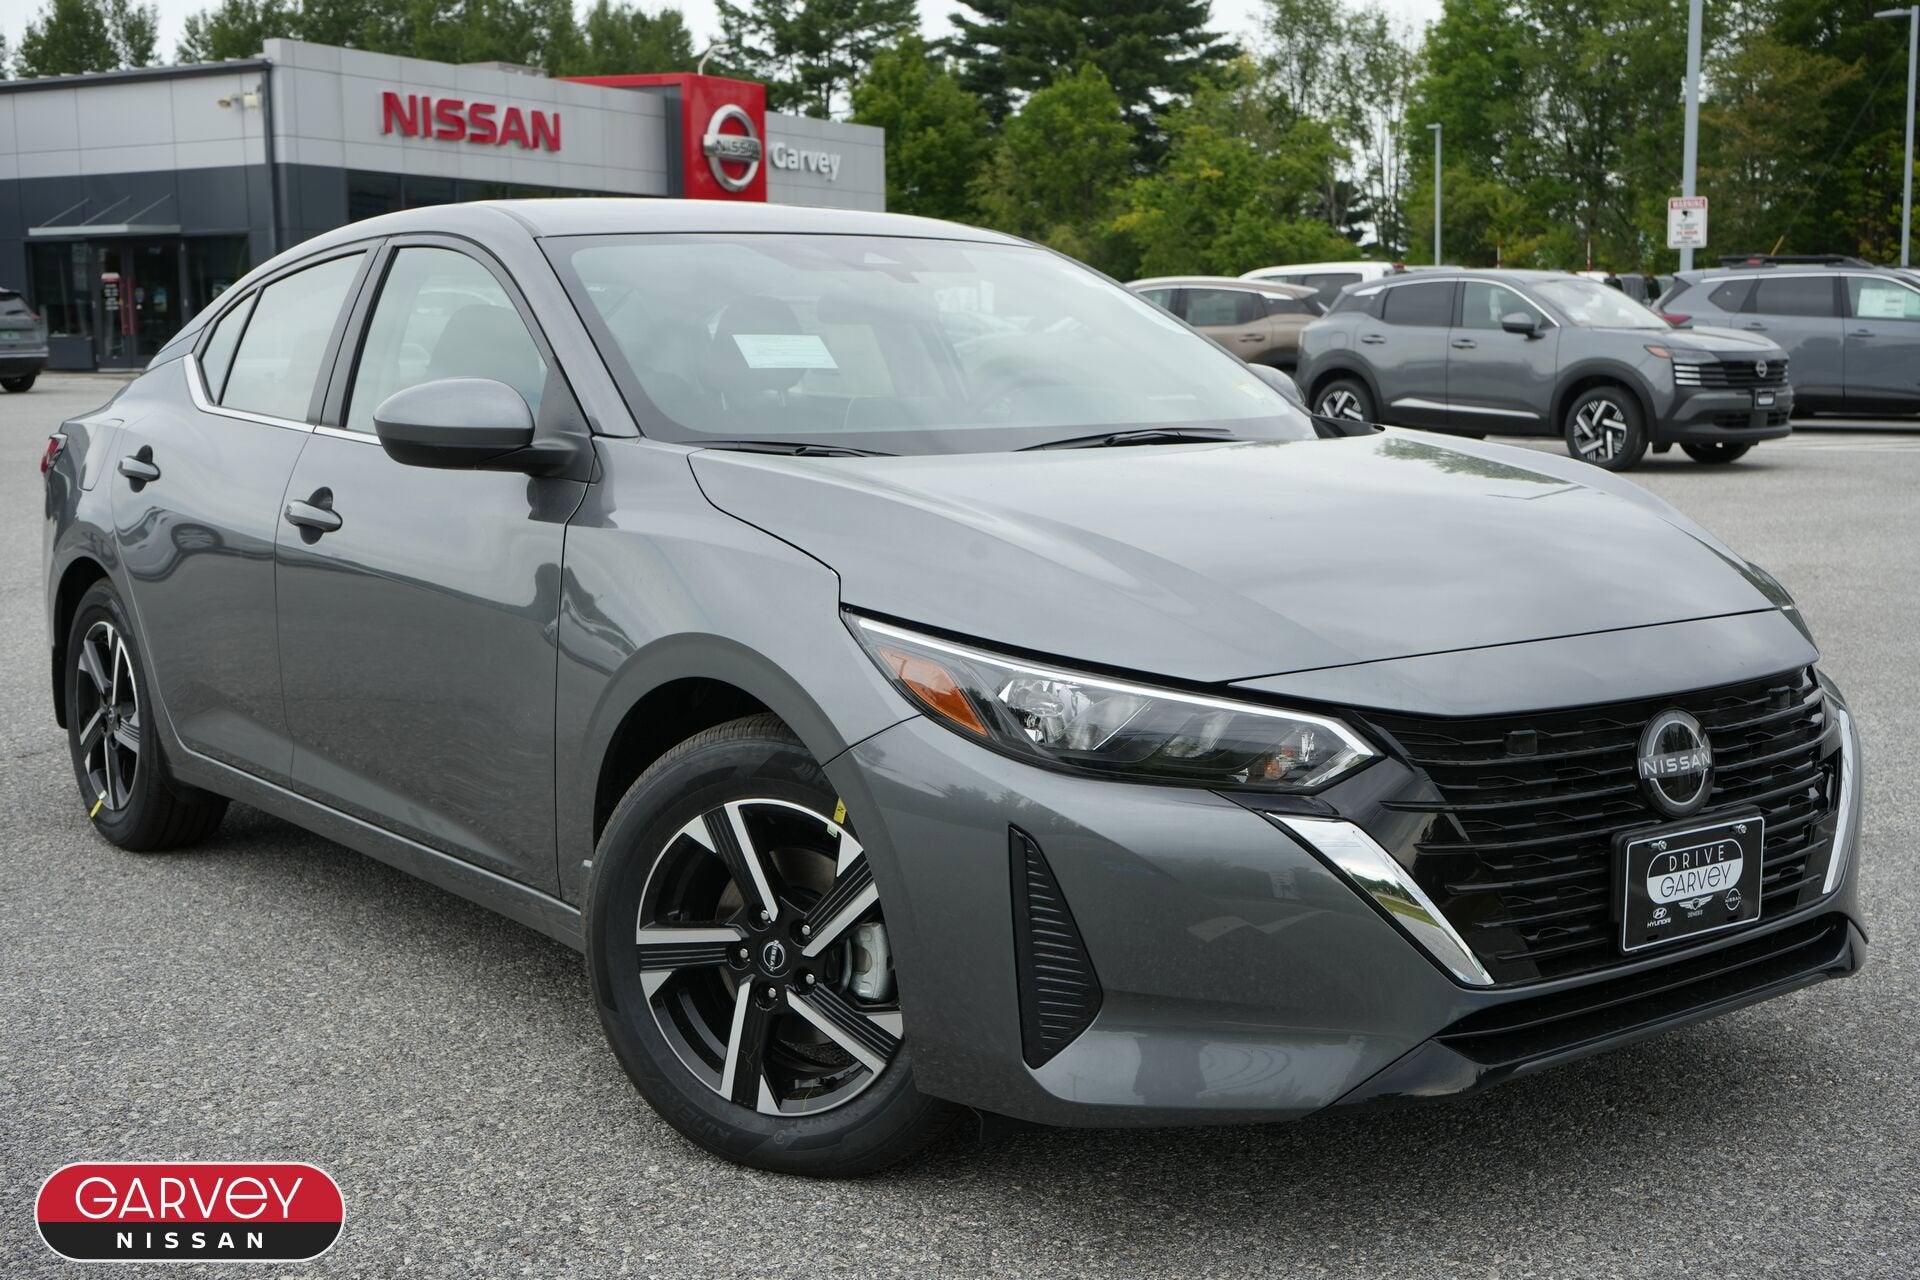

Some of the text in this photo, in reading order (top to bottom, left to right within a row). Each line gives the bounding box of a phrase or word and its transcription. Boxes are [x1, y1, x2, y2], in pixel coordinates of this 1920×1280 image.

[382, 92, 561, 152] NISSAN
[714, 140, 759, 157] NISSA
[772, 142, 841, 181] Garvey
[1643, 751, 1710, 775] NISSAN
[1669, 845, 1724, 872] DRIVE
[1647, 917, 1672, 928] HYUNDAI
